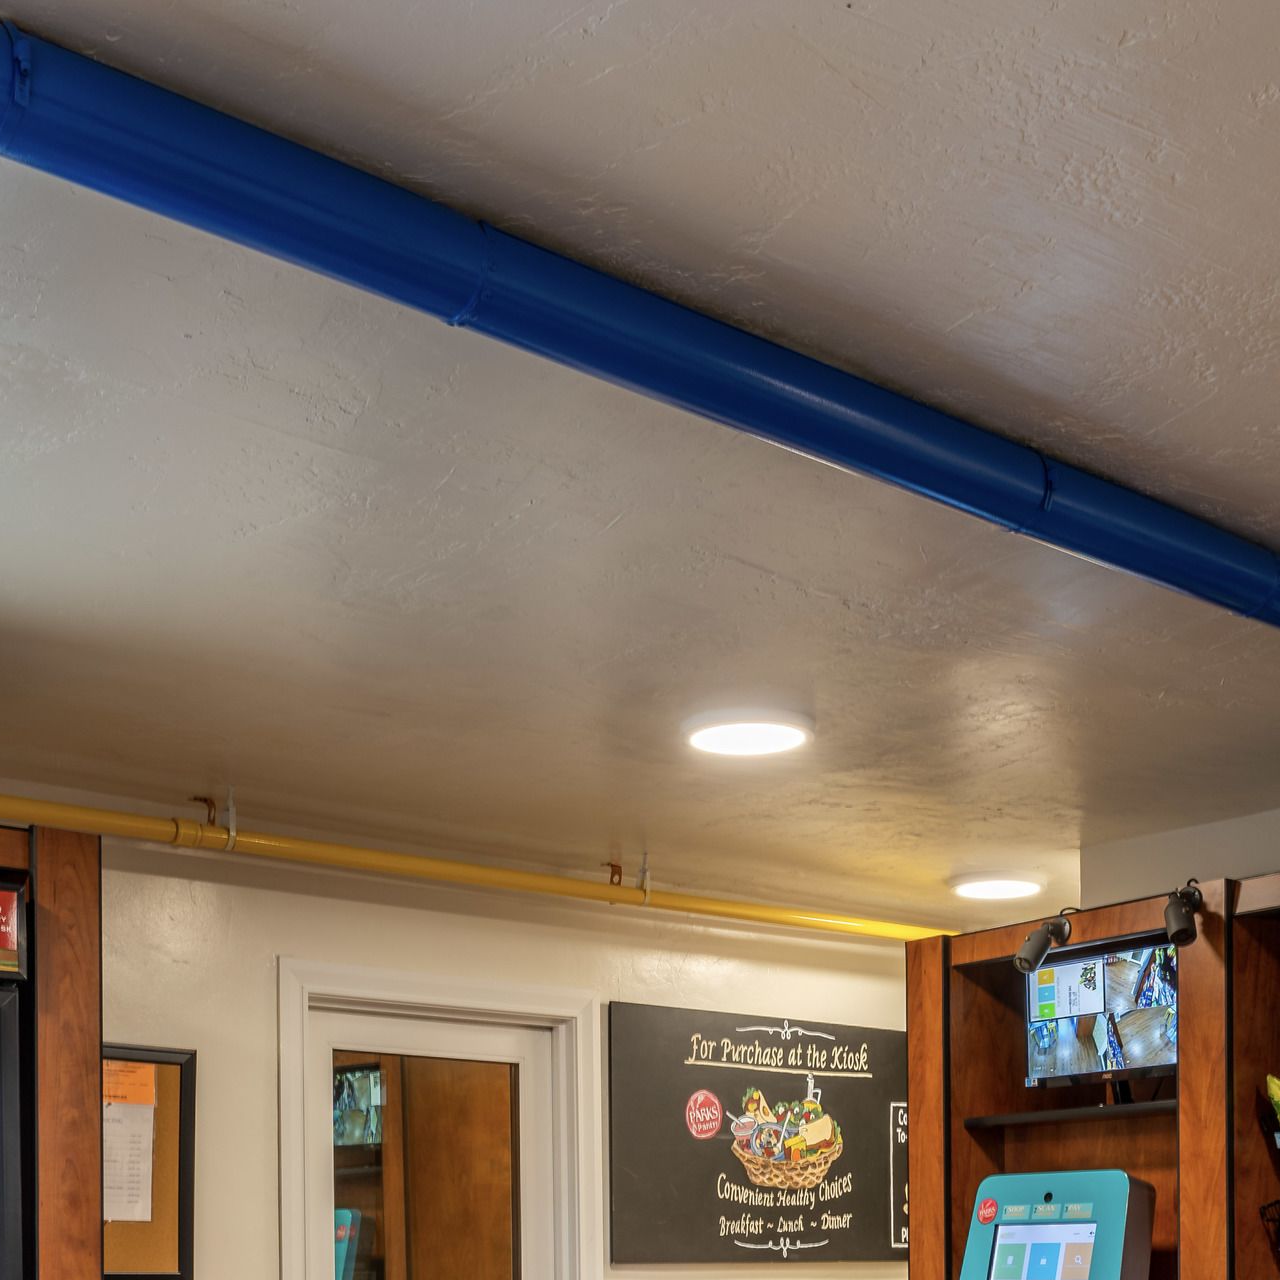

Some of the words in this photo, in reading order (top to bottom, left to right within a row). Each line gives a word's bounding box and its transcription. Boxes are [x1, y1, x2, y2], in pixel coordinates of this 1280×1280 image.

[688, 1033, 717, 1063] For
[720, 1037, 784, 1066] Purchase
[788, 1043, 802, 1066] at
[807, 1044, 826, 1068] the
[830, 1043, 869, 1071] Kiosk
[689, 1105, 719, 1122] PARKS
[717, 1173, 774, 1207] Convenient
[776, 1188, 815, 1210] Healthy
[819, 1172, 852, 1202] Choices
[719, 1213, 763, 1237] Breakfast
[777, 1214, 804, 1233] Lunch
[821, 1210, 852, 1230] Dinner
